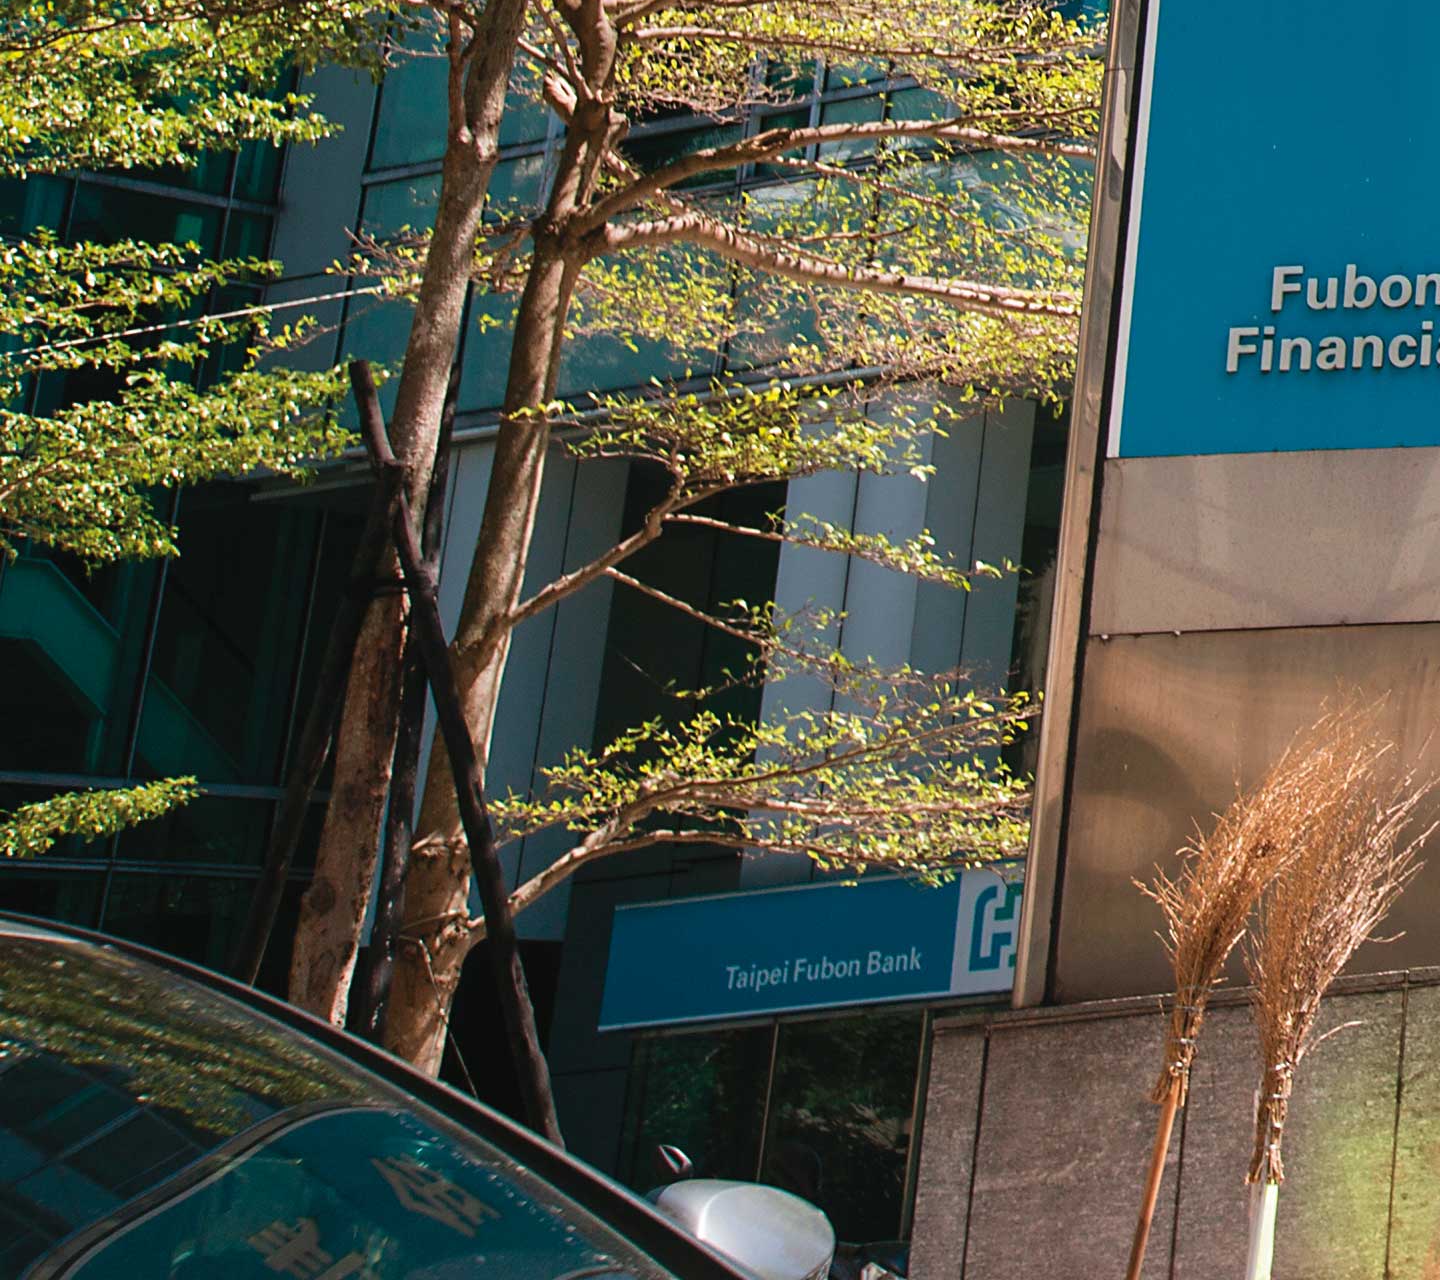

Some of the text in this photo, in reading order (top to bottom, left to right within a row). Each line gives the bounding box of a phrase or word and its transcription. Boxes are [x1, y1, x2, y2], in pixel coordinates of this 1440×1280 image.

[725, 946, 922, 992] Taipei Fubon Bank
